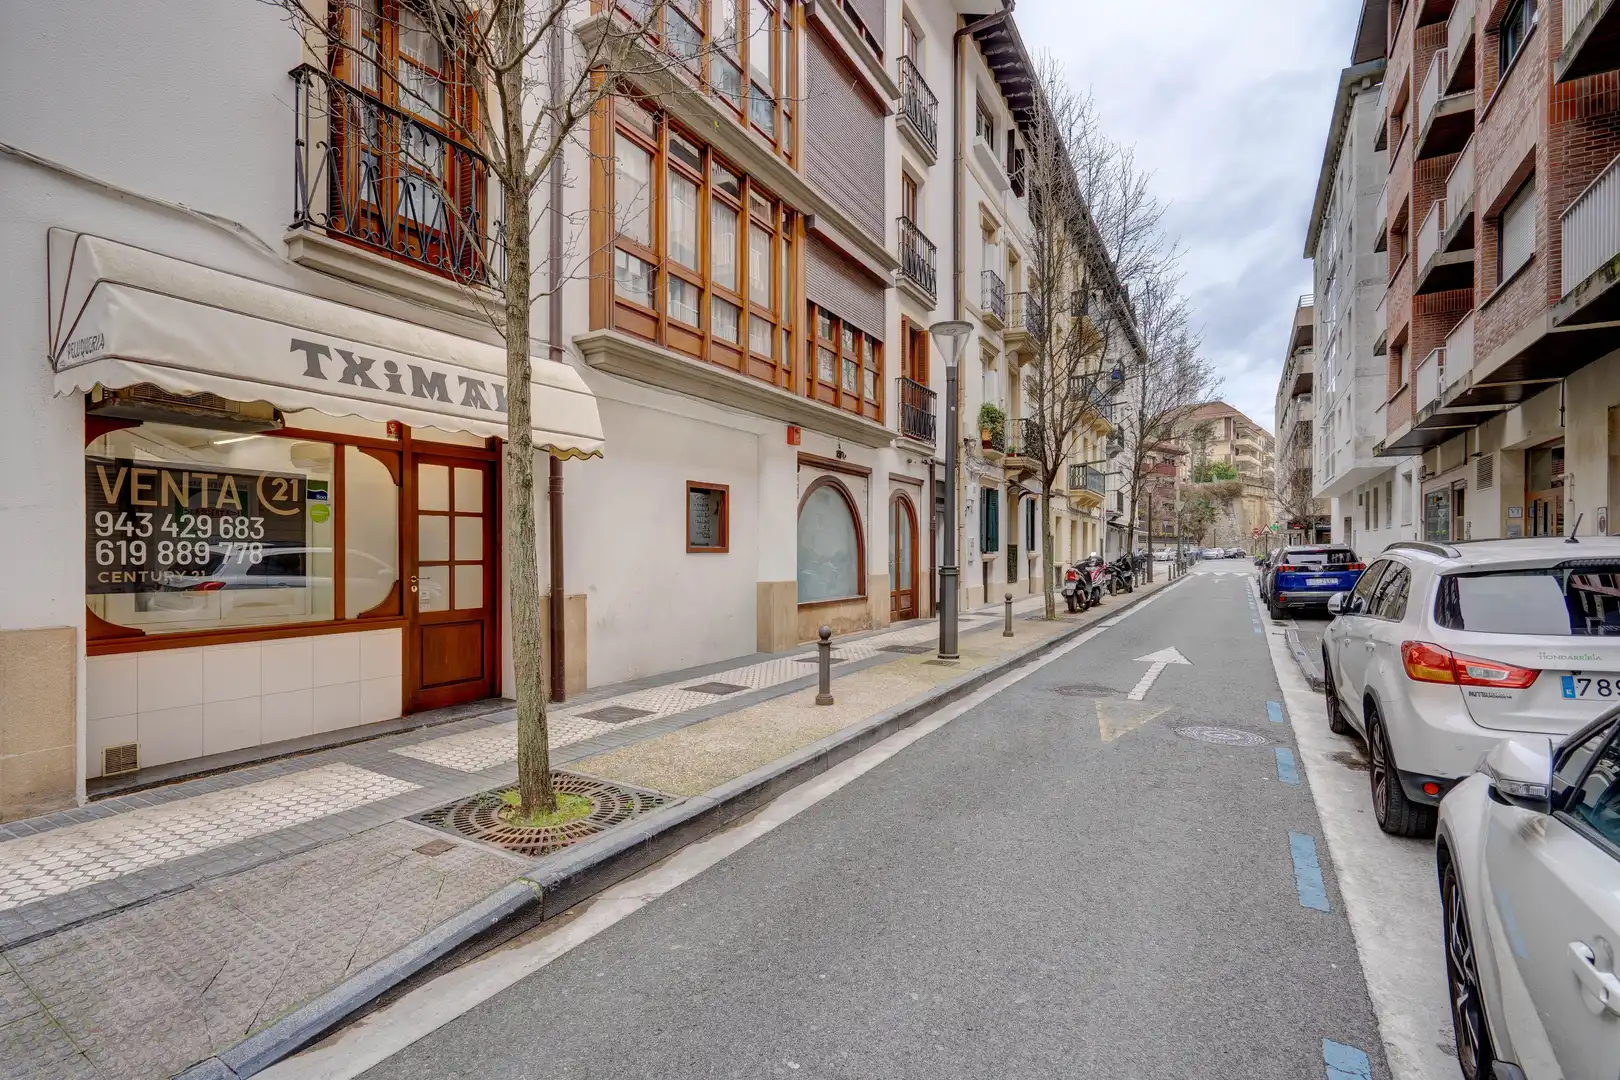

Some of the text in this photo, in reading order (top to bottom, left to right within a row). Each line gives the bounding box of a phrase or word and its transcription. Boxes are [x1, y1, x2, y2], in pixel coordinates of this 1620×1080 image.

[96, 464, 243, 510] VENTA
[94, 511, 265, 540] 943 429 683
[95, 539, 263, 566] 619 889 778
[97, 570, 186, 584] CENTURY
